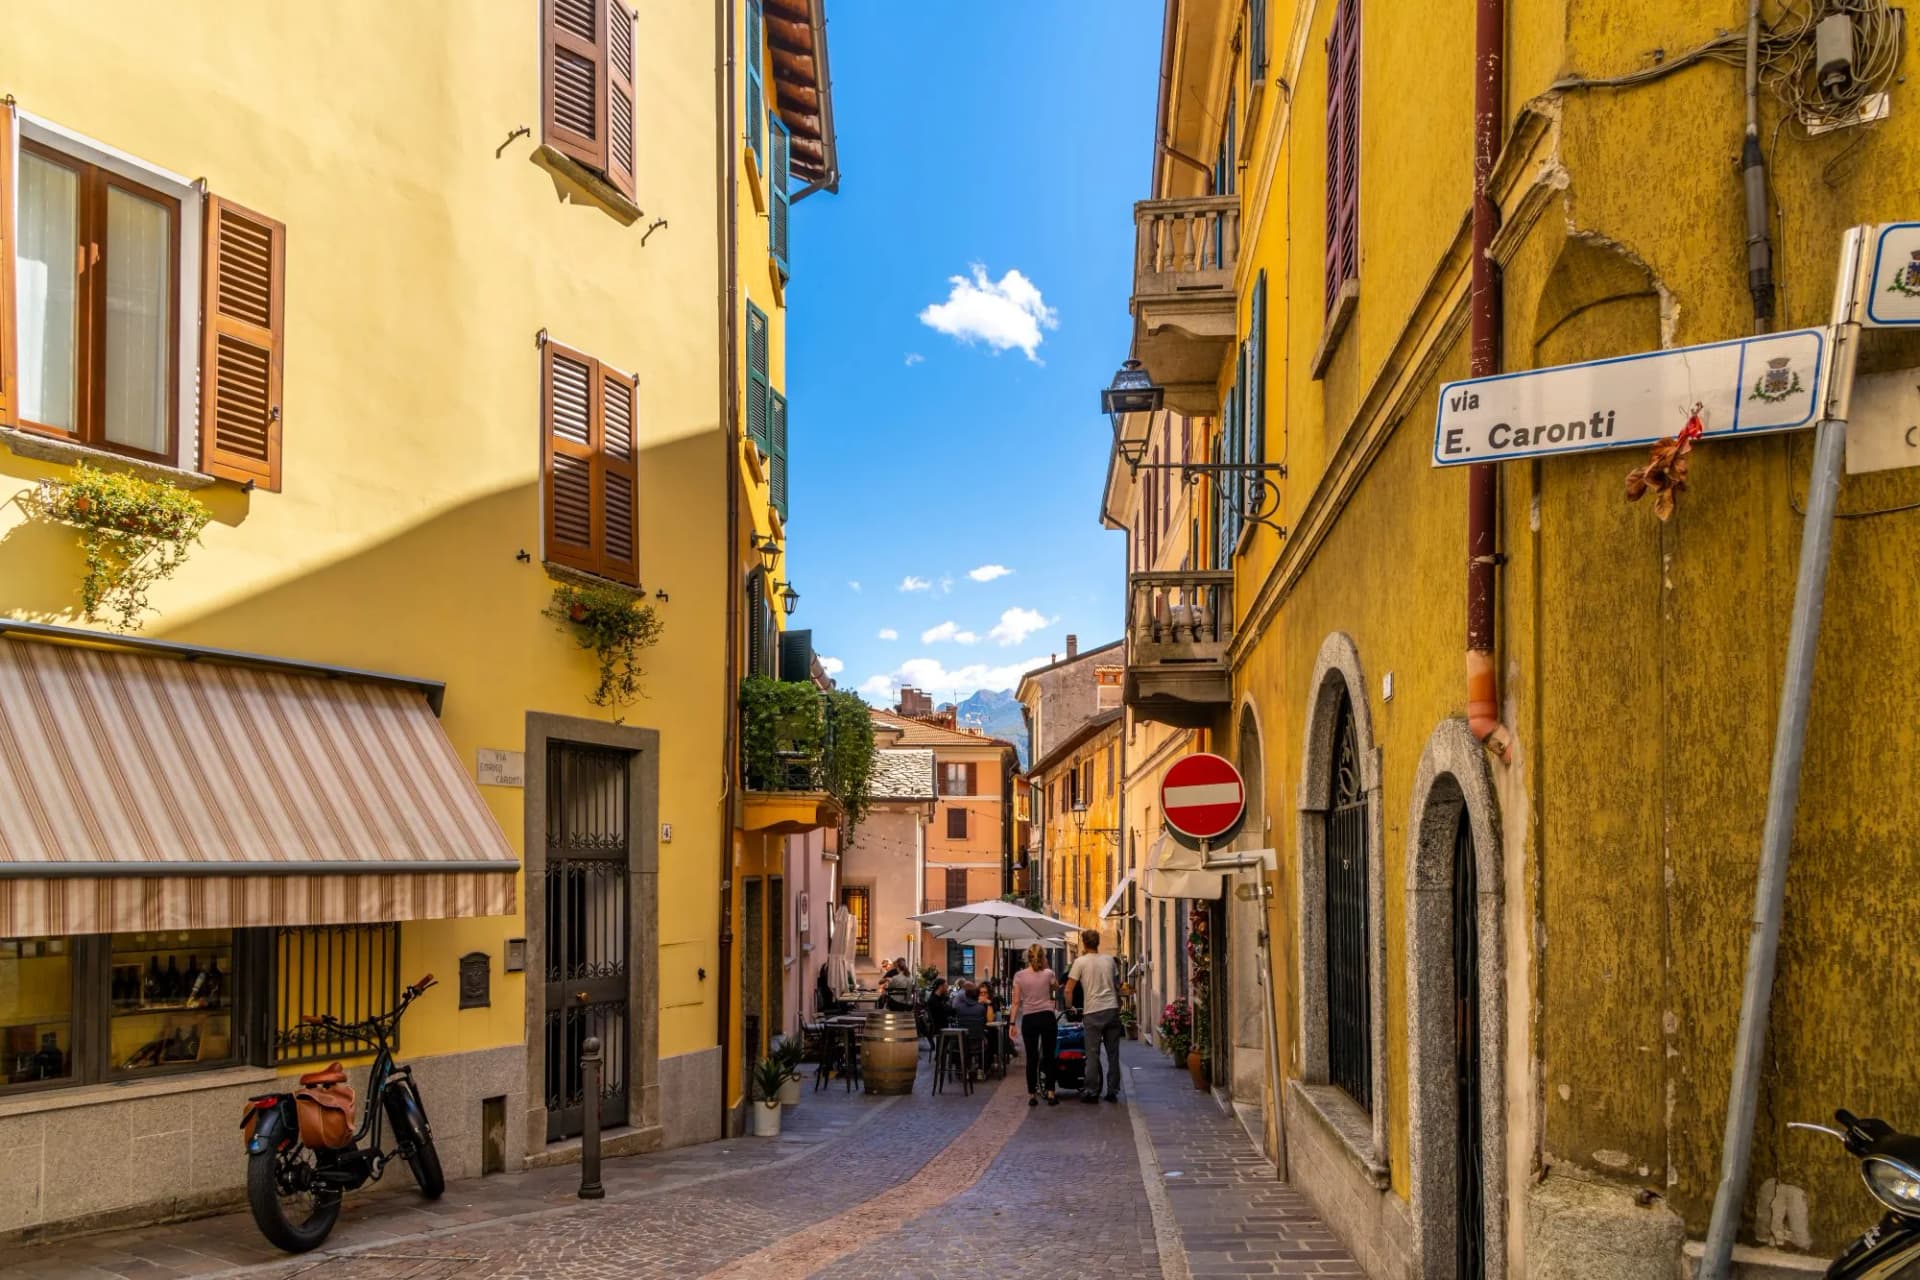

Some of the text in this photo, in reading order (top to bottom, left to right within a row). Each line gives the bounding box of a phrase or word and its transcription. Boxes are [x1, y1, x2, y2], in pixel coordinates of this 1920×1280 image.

[1451, 391, 1480, 412] via
[1444, 410, 1616, 454] E. Caronti
